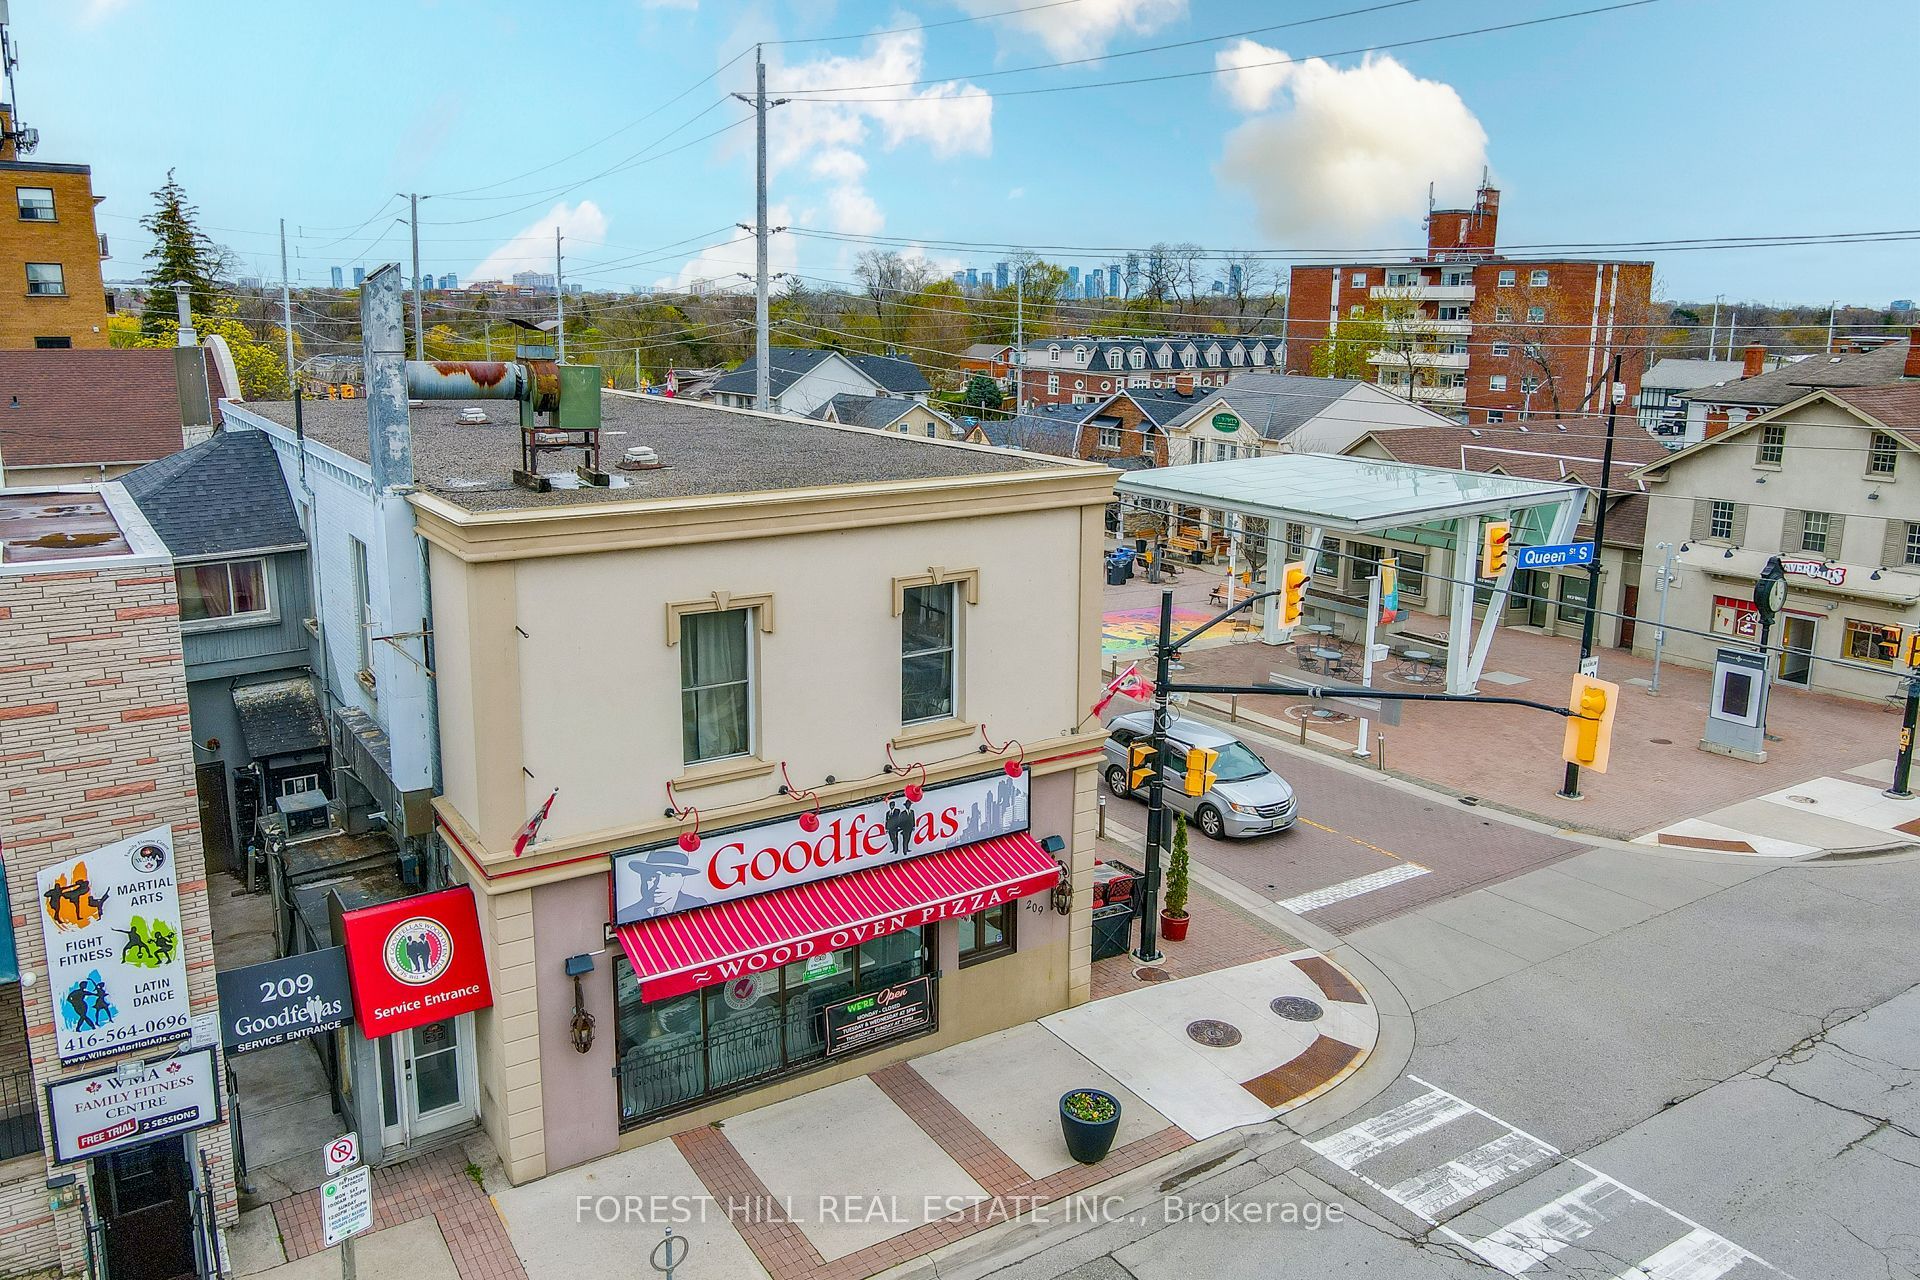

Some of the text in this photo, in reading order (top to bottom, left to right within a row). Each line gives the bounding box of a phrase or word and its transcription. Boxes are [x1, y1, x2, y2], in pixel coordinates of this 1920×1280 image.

[1525, 550, 1566, 564] Queen
[1579, 546, 1588, 560] S
[707, 802, 959, 890] Goodfeas
[117, 877, 174, 896] MARTIAL
[131, 892, 163, 907] ARTS
[1026, 900, 1044, 915] 209
[424, 924, 444, 938] WOOD
[717, 888, 1002, 979] WOOD OVEN PIZZA
[66, 936, 103, 952] FIGHT
[59, 948, 113, 967] FITNESS
[135, 978, 170, 994] LATIN
[260, 974, 314, 1002] 209
[133, 990, 175, 1008] DANCE
[374, 984, 480, 1020] Service Entrance
[847, 988, 908, 1013] WE'RE Open
[235, 994, 342, 1036] Goodfeas
[856, 1010, 878, 1020] MONDAY
[882, 1003, 901, 1012] CLOSED
[64, 1013, 187, 1052] 416-564-0696
[842, 1024, 864, 1034] TUESDAY
[870, 1013, 899, 1025] WEDNESDAY
[237, 1020, 342, 1052] SERVICE ENTRANCE
[74, 1076, 194, 1114] FAMILY FITNESS
[106, 1096, 168, 1119] CENTRE
[143, 1110, 197, 1130] 2 SESSIONS
[80, 1122, 135, 1148] FREE TRIAL
[350, 1186, 358, 1194] SAT
